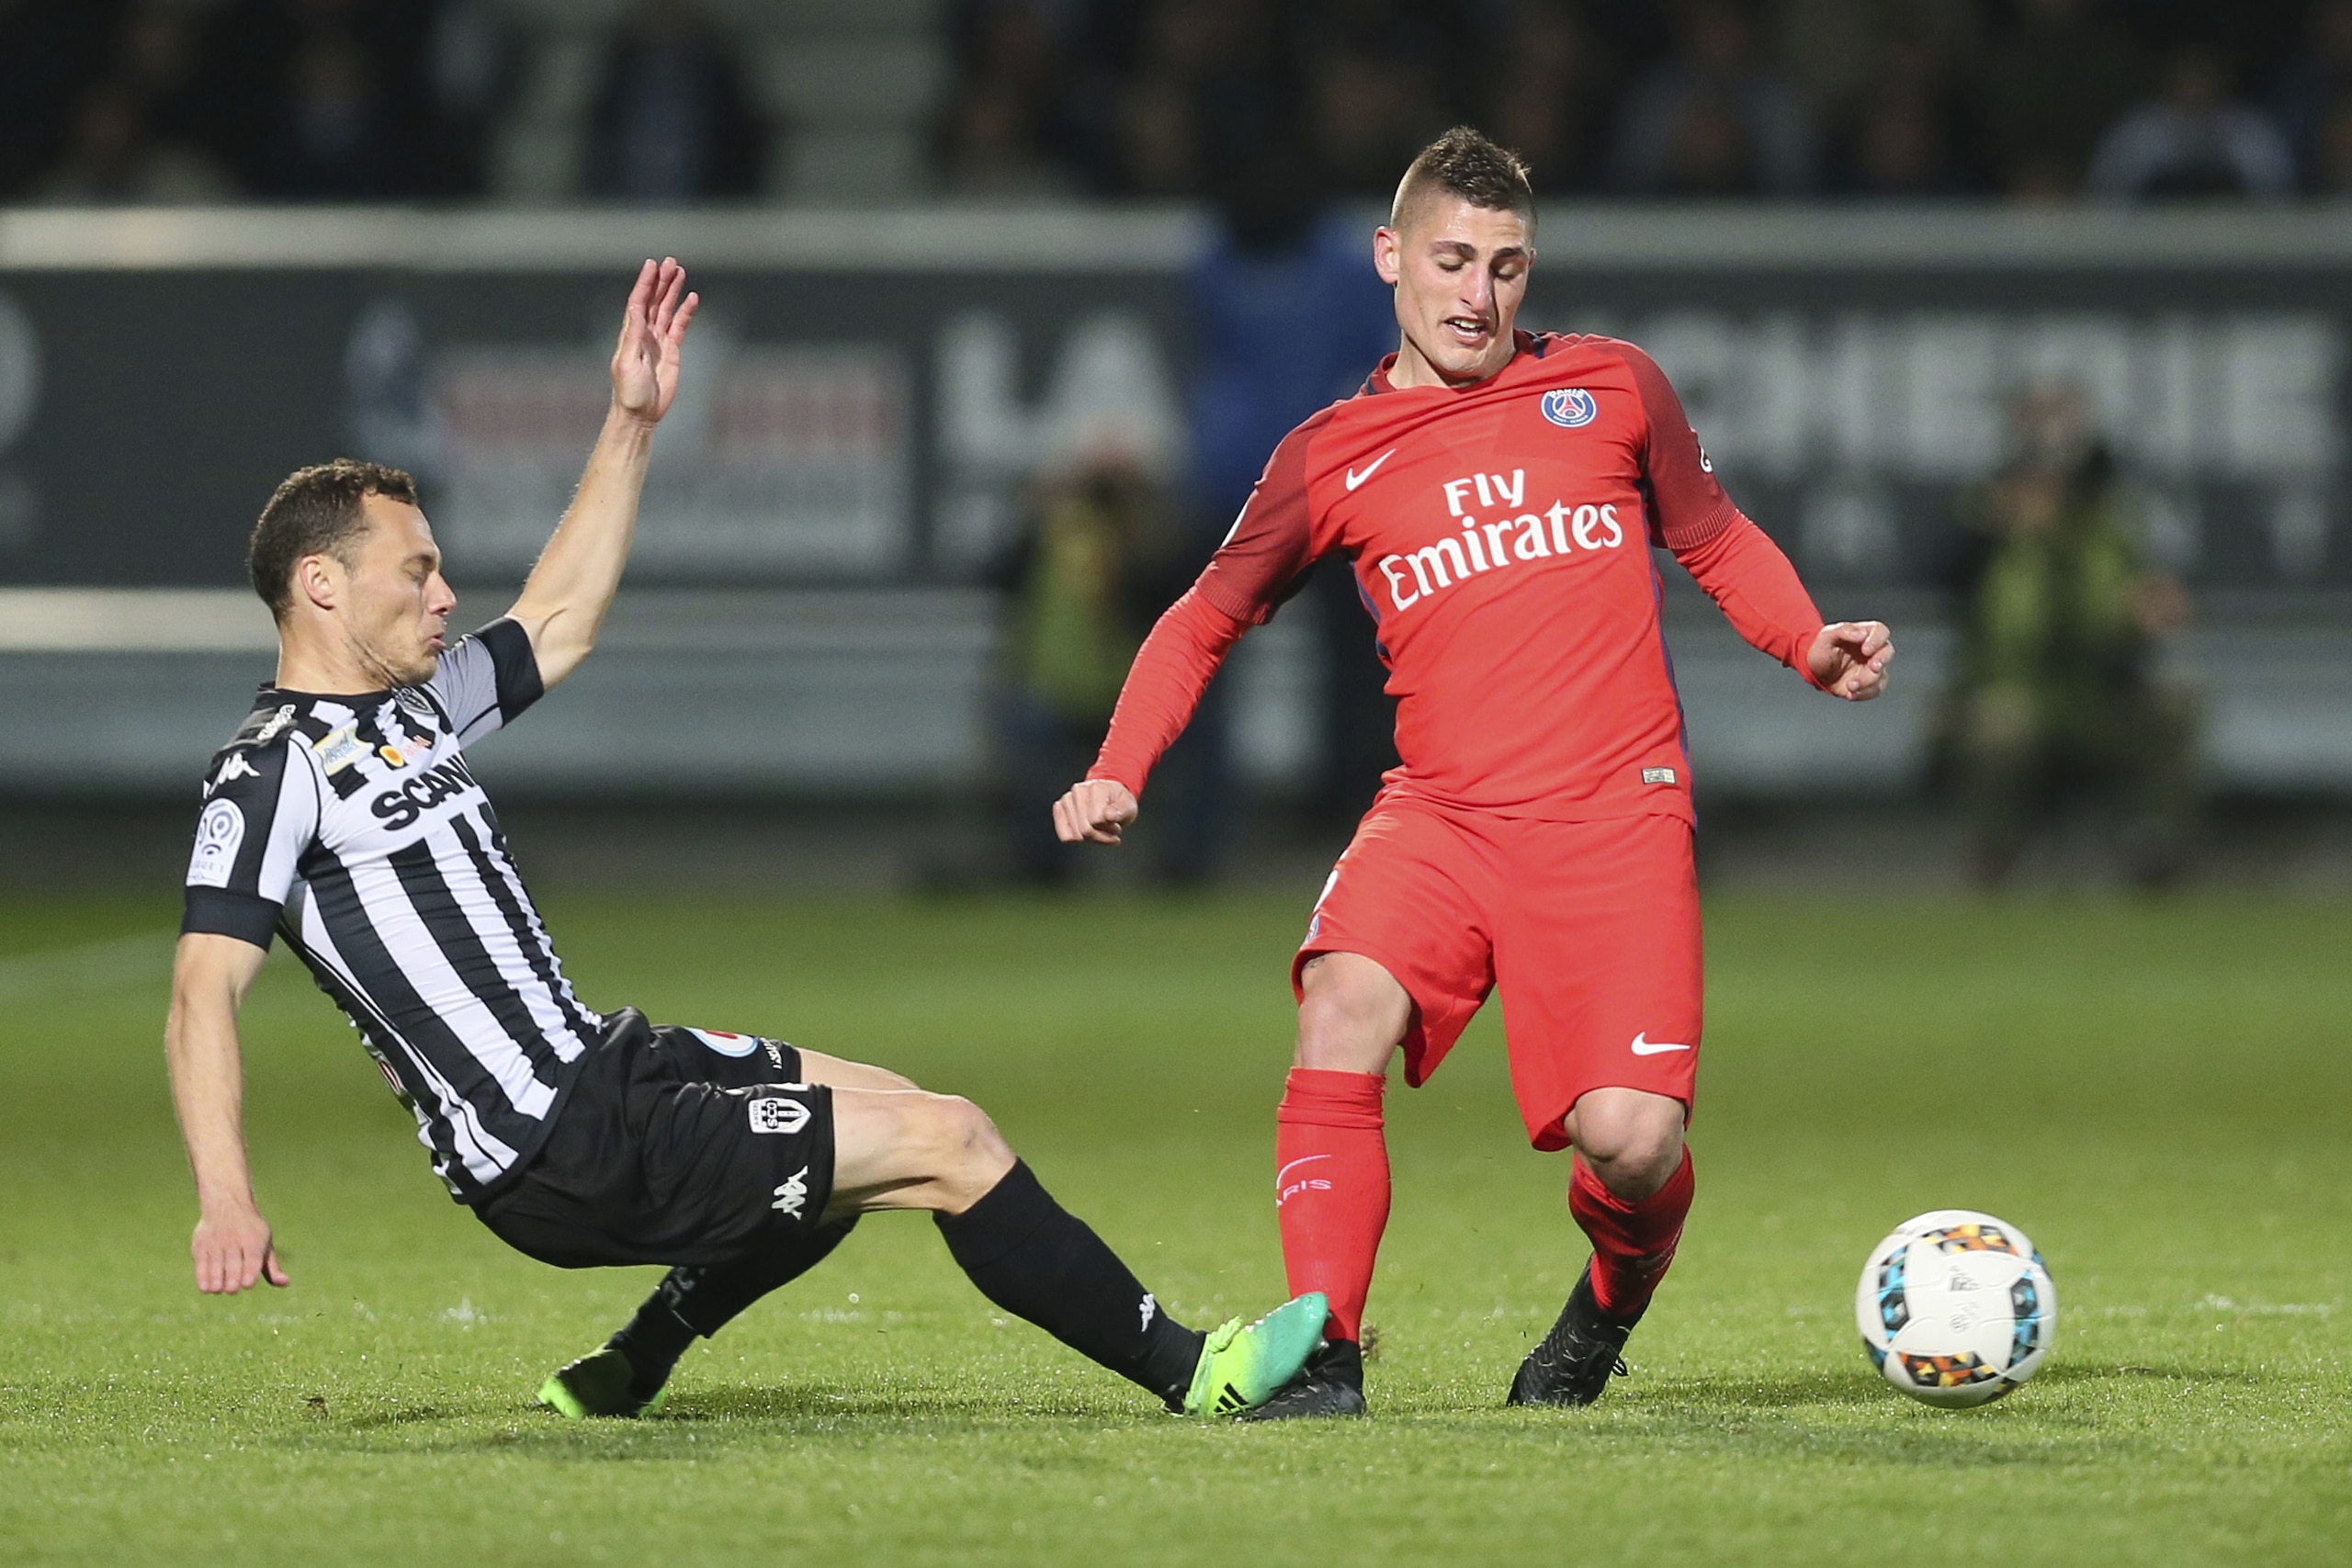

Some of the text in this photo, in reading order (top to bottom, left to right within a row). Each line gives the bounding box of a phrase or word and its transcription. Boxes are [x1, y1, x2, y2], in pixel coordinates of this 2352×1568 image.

[1442, 468, 1524, 517] Fly
[1378, 499, 1623, 612] Emirates
[766, 1101, 778, 1129] SCO
